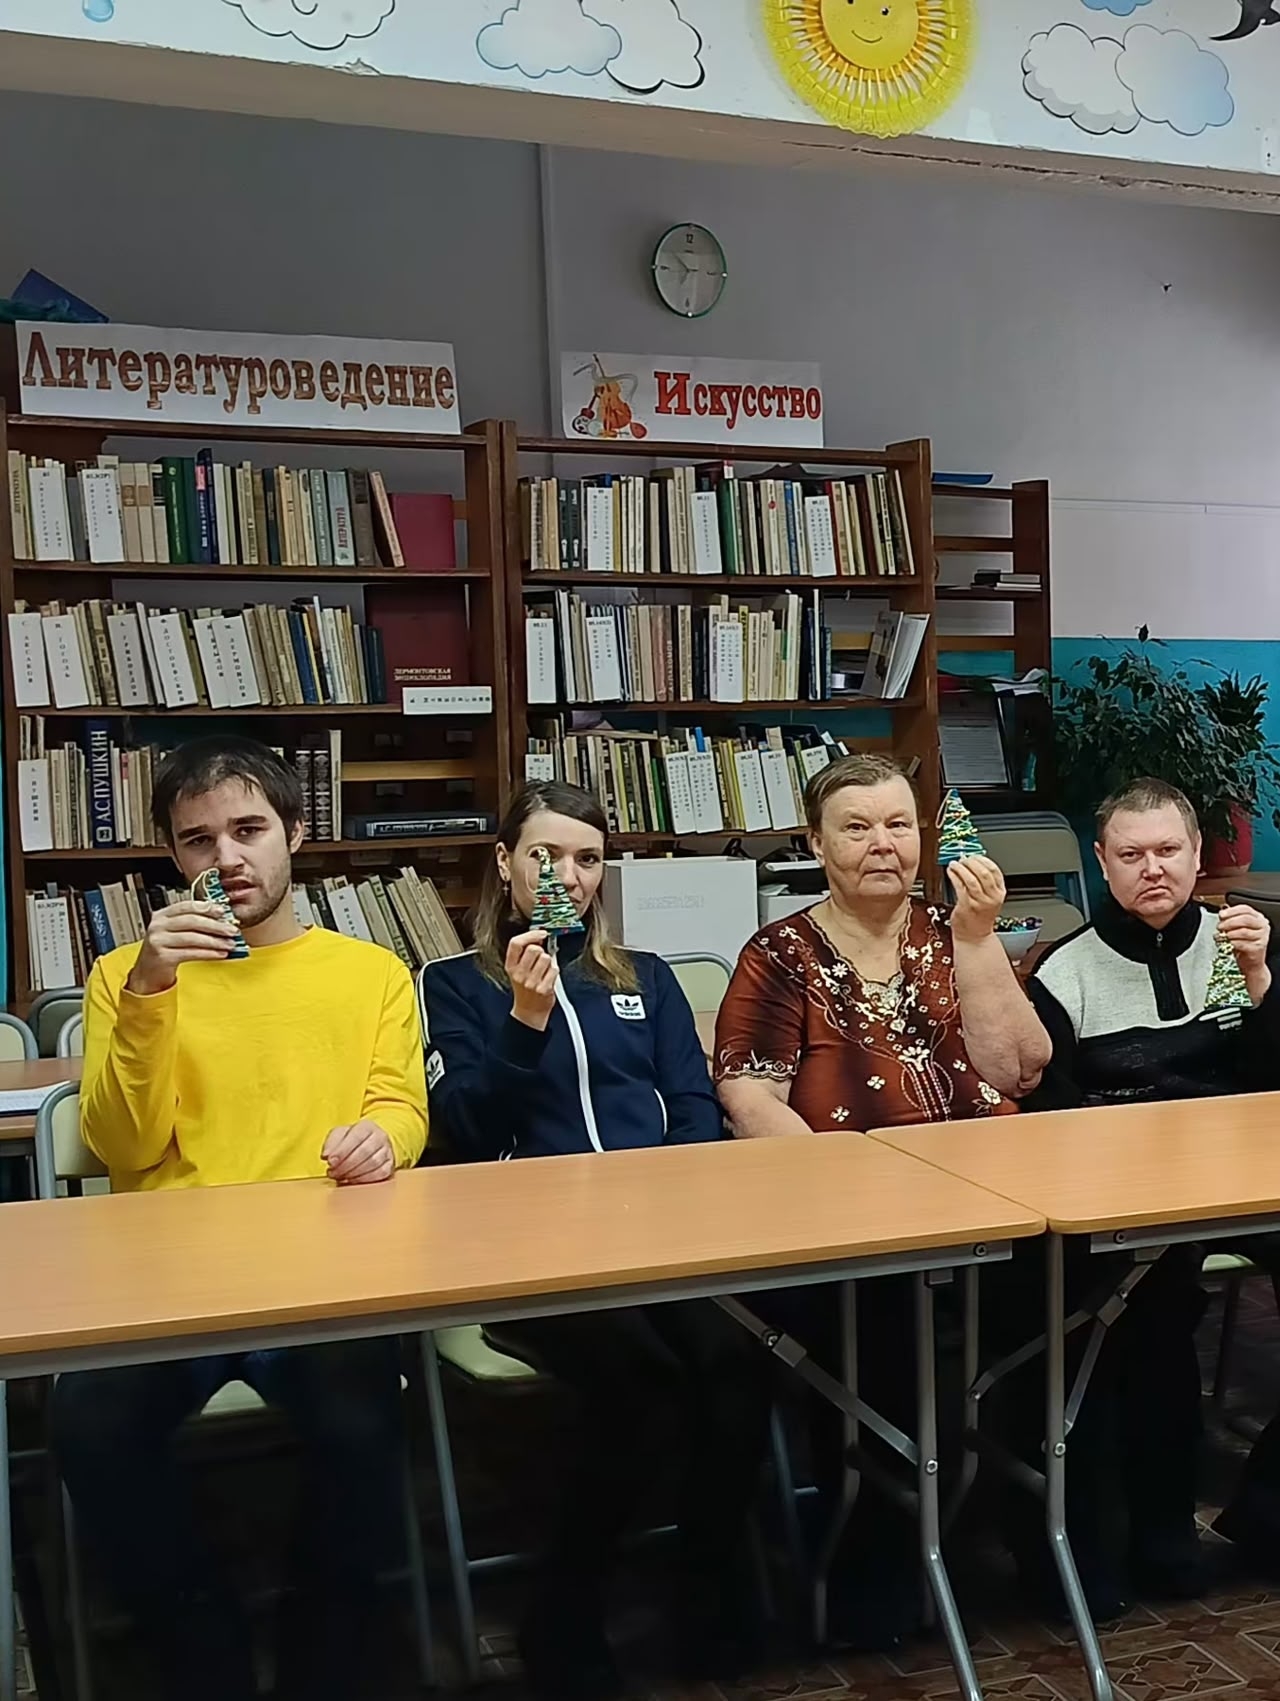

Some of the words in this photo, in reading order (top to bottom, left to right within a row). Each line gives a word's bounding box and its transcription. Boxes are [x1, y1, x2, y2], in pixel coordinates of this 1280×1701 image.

[686, 233, 694, 244] 12
[22, 332, 455, 414] Литературоведение
[654, 371, 822, 430] Искусство
